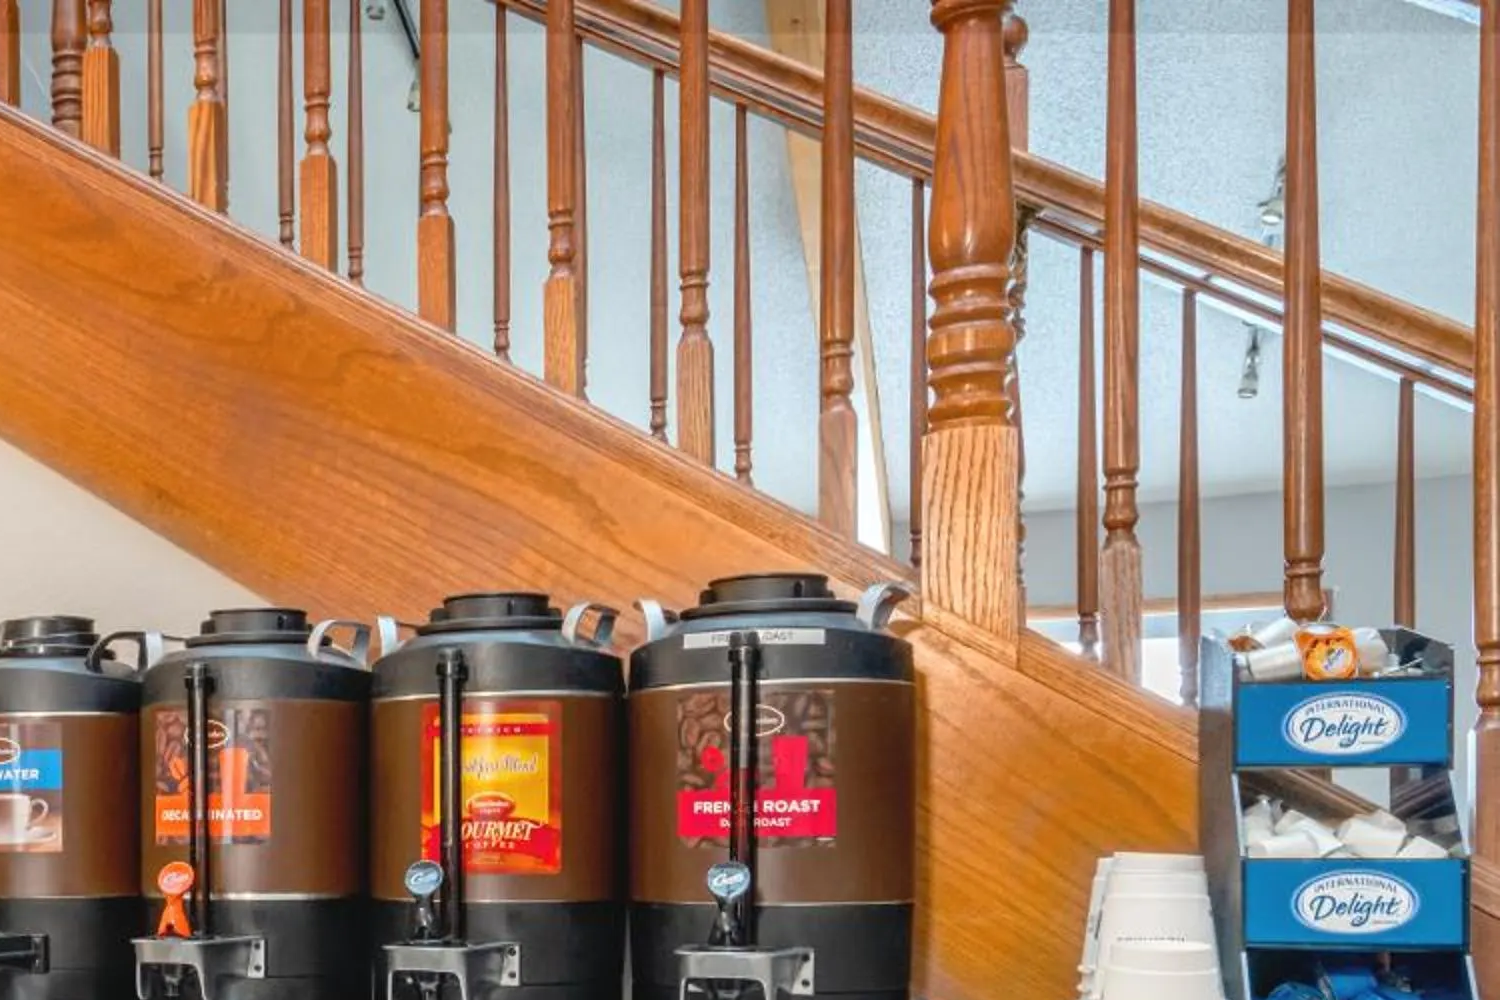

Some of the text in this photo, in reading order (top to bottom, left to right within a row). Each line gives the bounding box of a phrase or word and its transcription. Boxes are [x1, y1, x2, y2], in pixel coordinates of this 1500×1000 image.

[1305, 699, 1386, 715] INTERNATIONAL
[1300, 713, 1389, 748] Delight
[693, 799, 821, 814] FREN ROAST
[161, 809, 263, 821] DECAINATED
[754, 817, 792, 827] ROAST
[461, 820, 542, 841] OURMET
[1313, 877, 1398, 893] INTERNATIONAL
[1309, 892, 1402, 927] Delight
